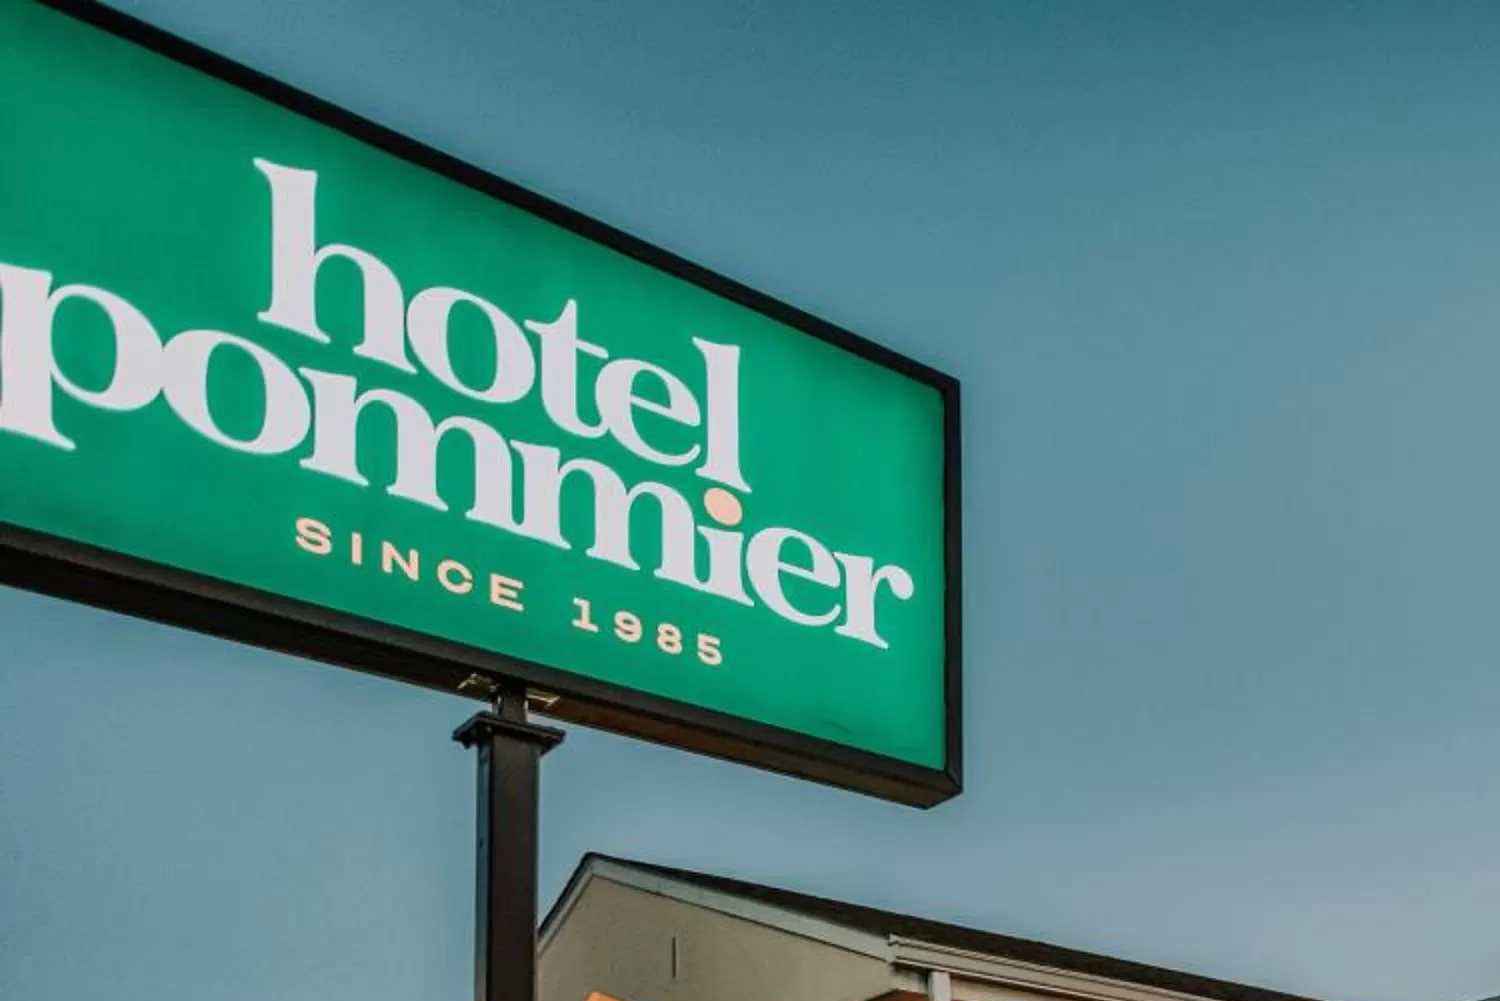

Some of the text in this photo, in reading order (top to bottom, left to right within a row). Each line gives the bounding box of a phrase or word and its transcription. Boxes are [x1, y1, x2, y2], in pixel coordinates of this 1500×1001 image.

[0, 264, 914, 649] pommier
[254, 158, 752, 493] hotel
[295, 517, 723, 665] SINCE 1985
